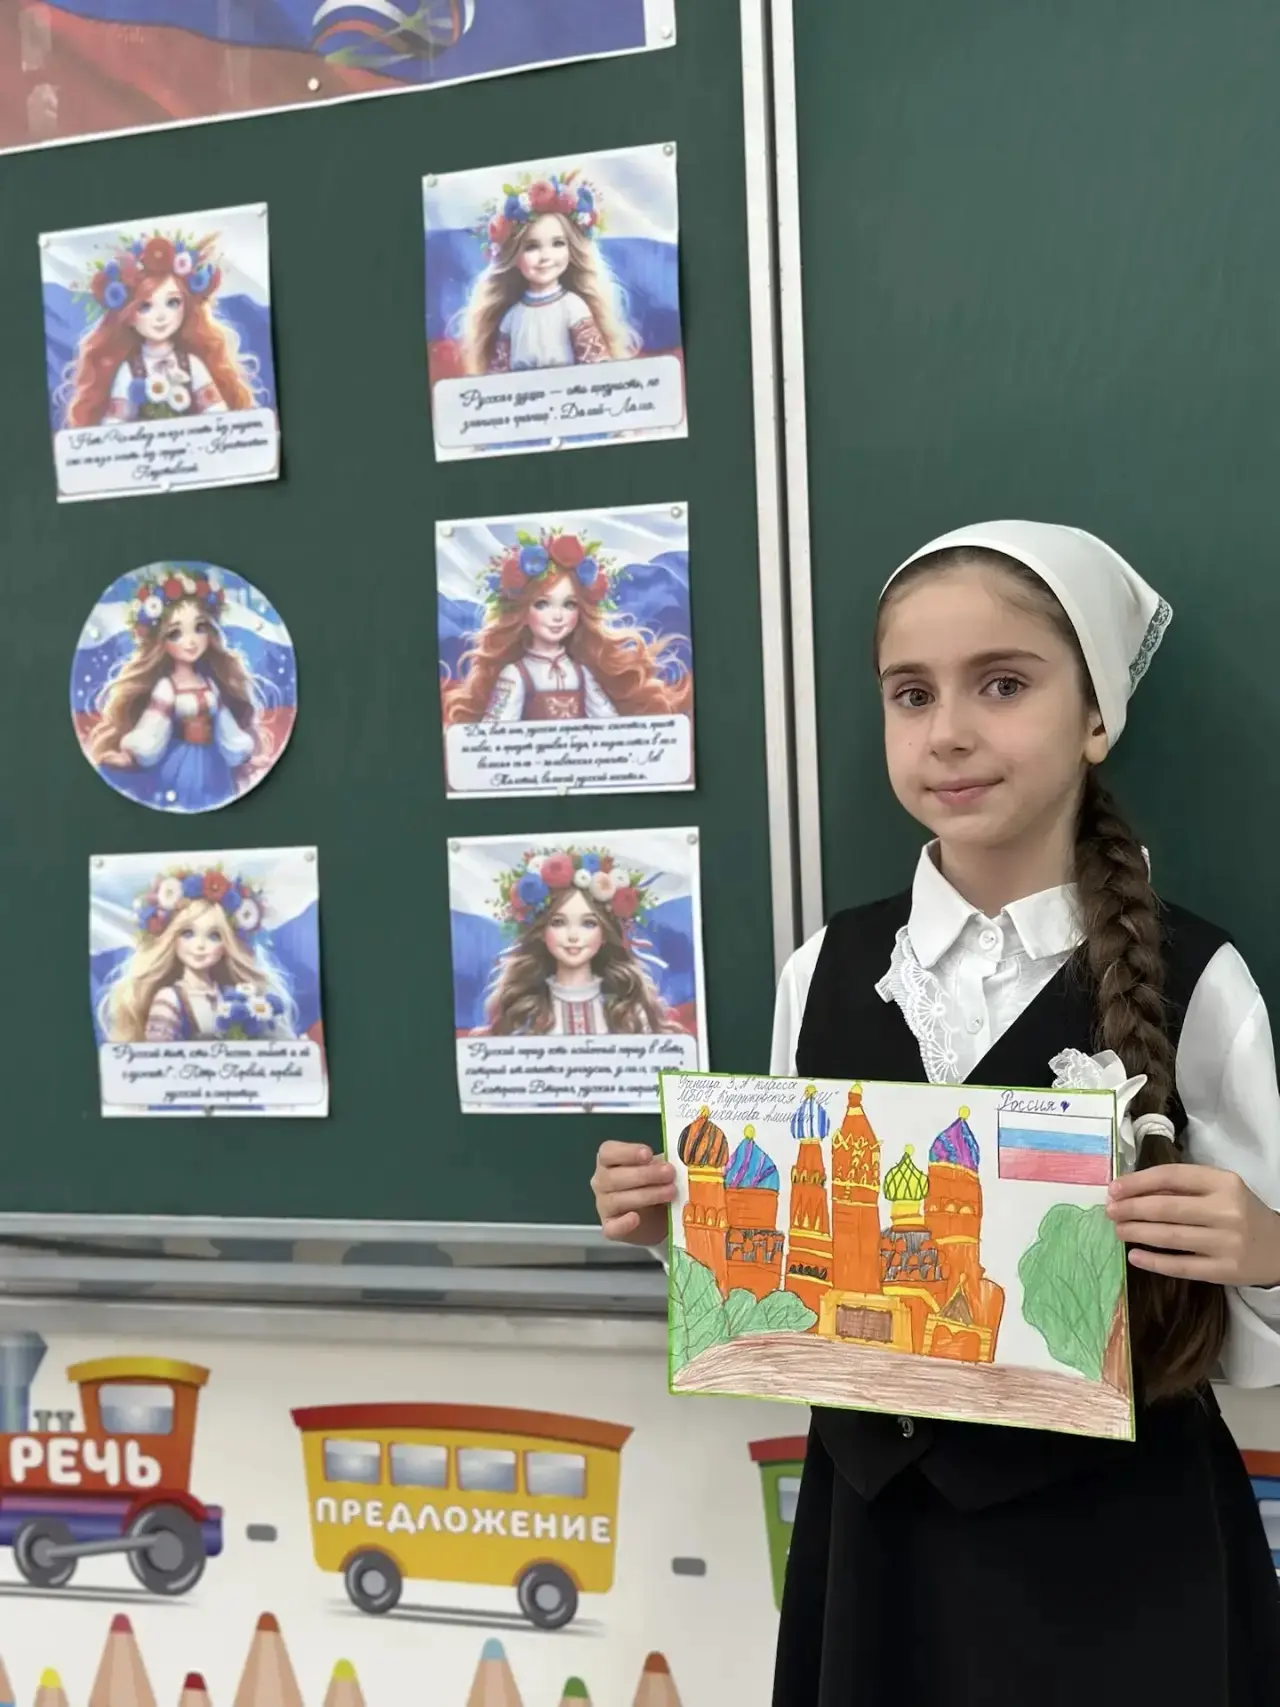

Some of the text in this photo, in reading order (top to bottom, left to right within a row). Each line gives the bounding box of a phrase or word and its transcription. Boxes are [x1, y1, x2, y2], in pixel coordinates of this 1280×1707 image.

[998, 1090, 1057, 1112] Россия
[9, 1435, 162, 1488] РЕЧЬ
[315, 1497, 611, 1544] ПРЕДЛОЖЕНИЕ
